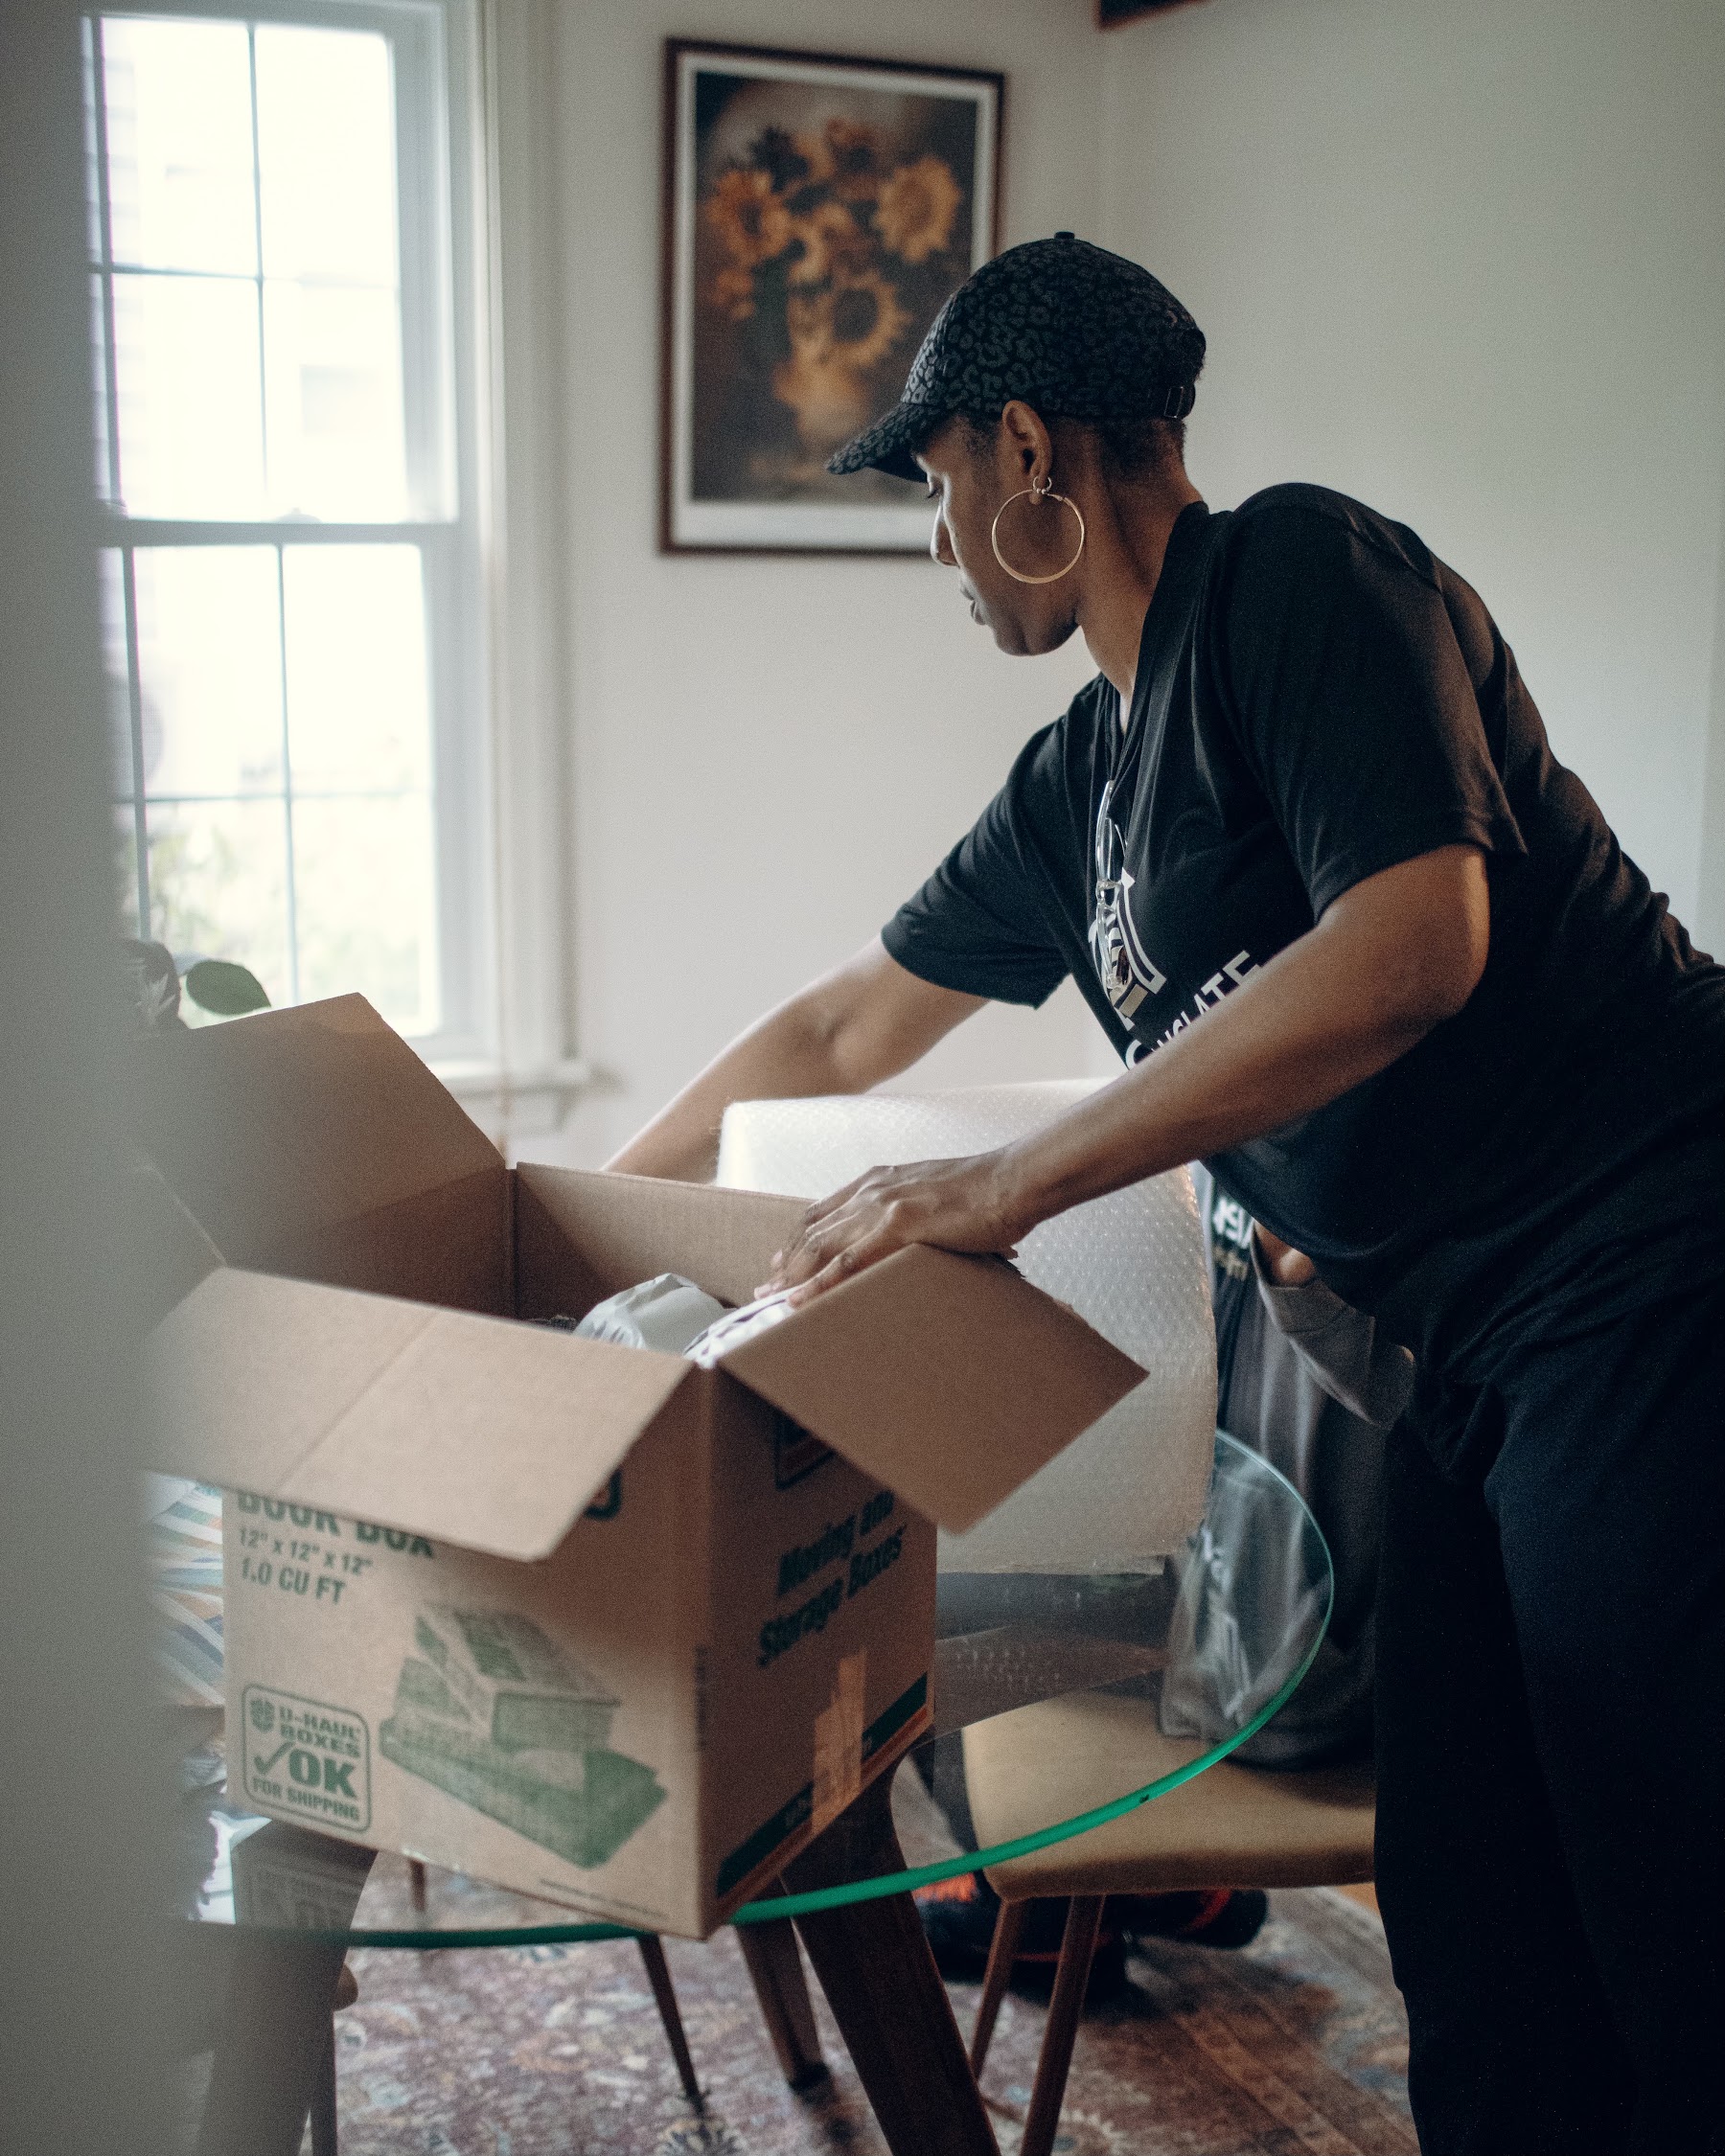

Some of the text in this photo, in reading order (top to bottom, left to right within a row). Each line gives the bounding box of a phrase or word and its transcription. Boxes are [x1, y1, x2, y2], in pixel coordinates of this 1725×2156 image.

[242, 1556, 346, 1605] 1.0 CU FT
[279, 1723, 361, 1758] BOXES
[288, 1748, 358, 1800] OK
[252, 1777, 360, 1823] FOR SHIPPING
